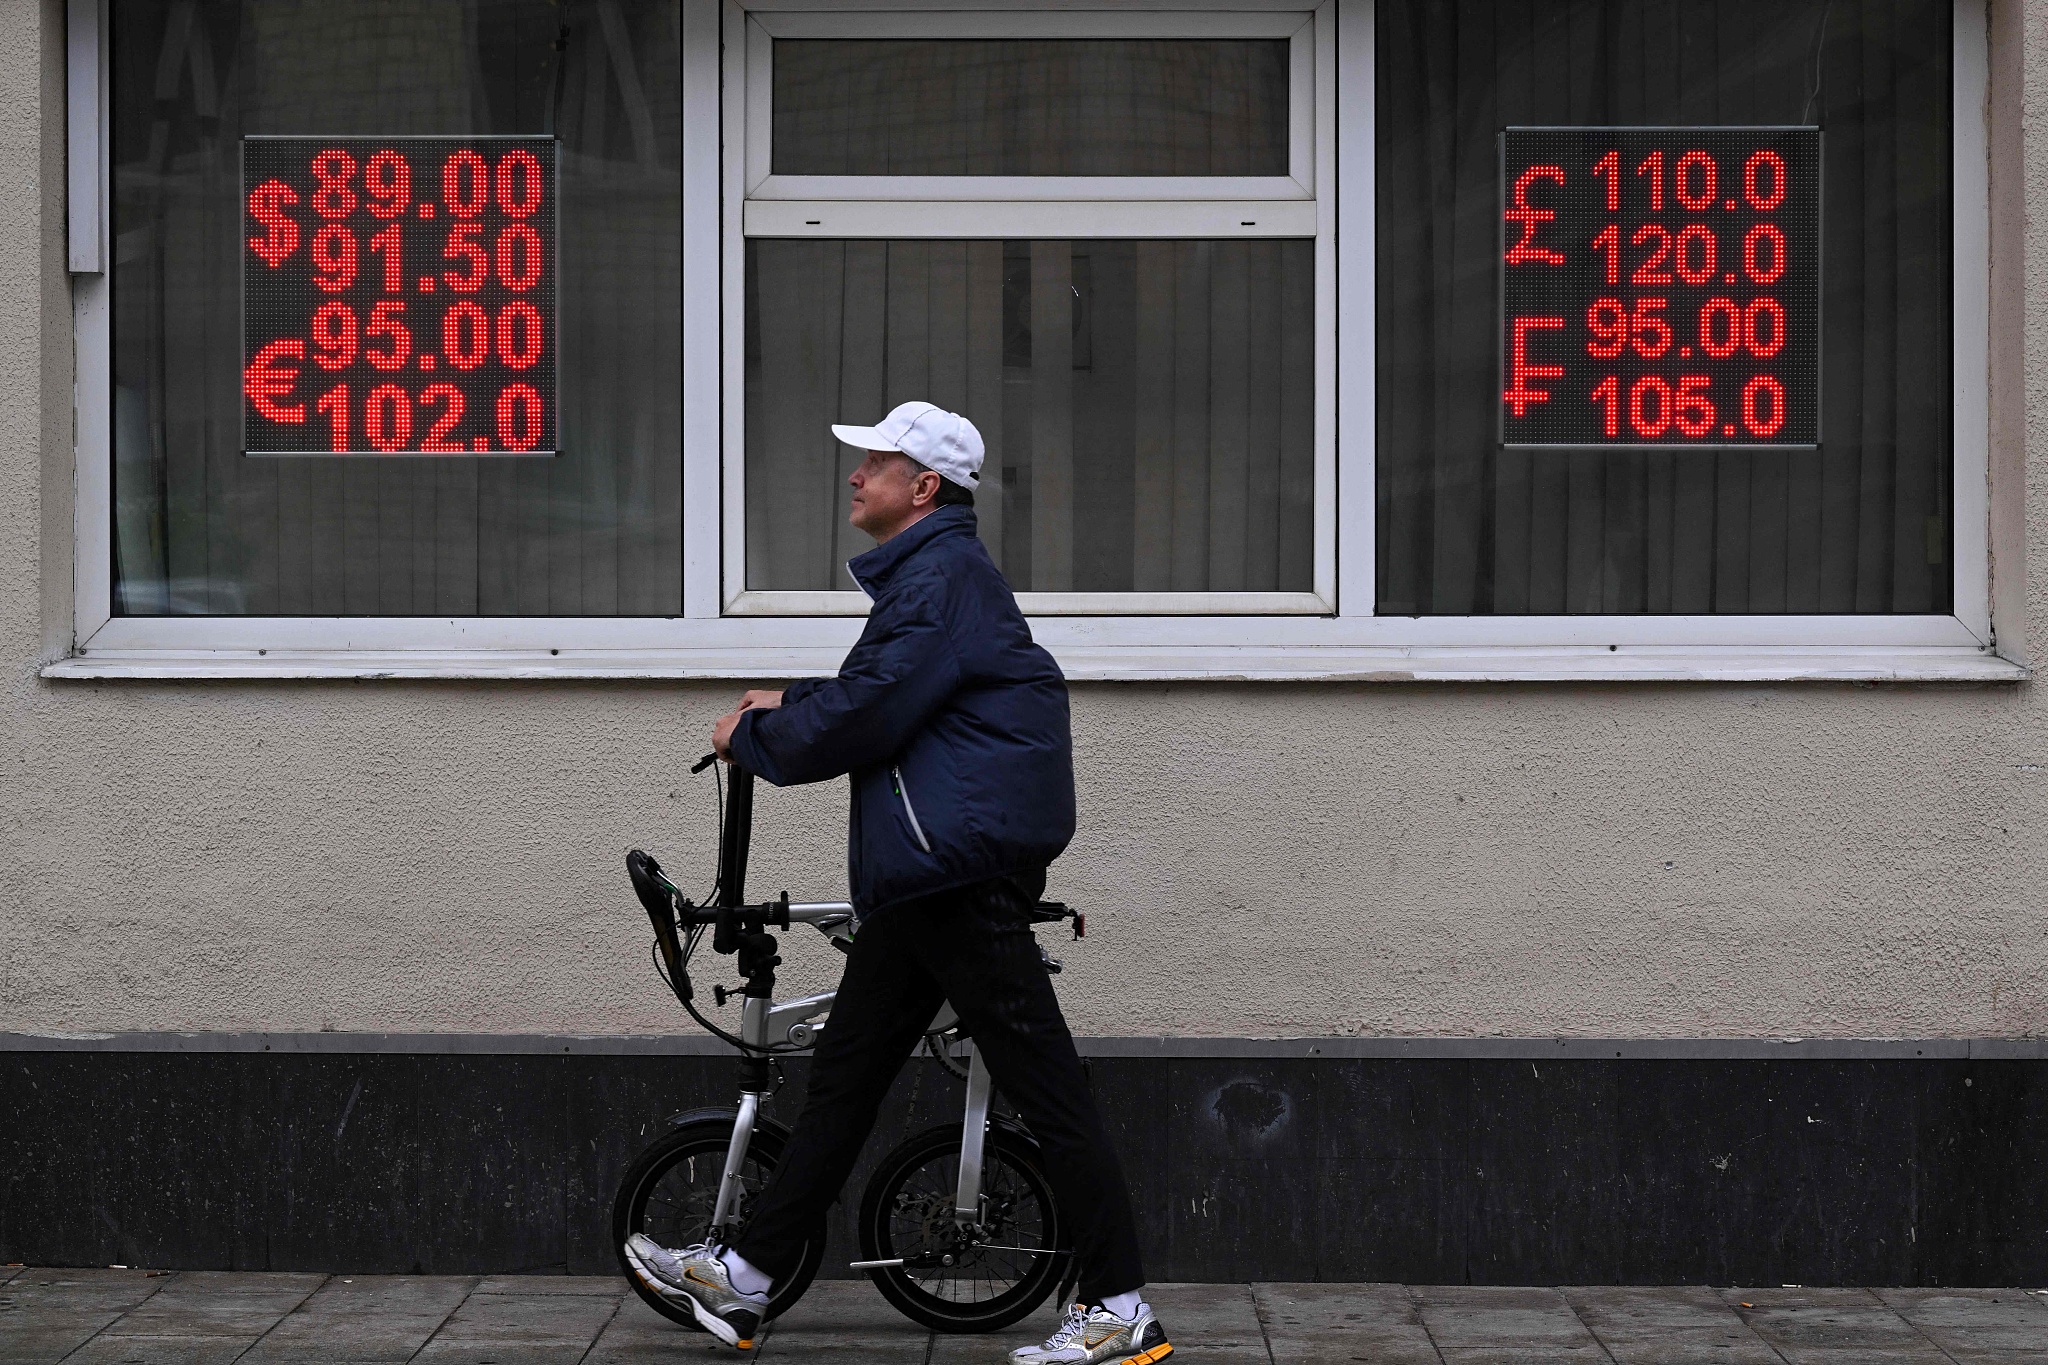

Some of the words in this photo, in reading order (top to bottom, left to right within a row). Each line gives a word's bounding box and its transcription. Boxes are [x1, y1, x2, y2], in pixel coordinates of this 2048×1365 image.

[311, 149, 542, 220] 89.00
[1593, 150, 1786, 211] 110.0
[248, 180, 301, 268] $
[311, 221, 542, 293] 91.50
[1592, 223, 1786, 286] 120.0
[311, 299, 543, 372] 95.00
[1586, 296, 1785, 359] 95.00
[243, 338, 307, 424] €
[1591, 374, 1785, 438] 105.0
[316, 382, 543, 453] 102.0
